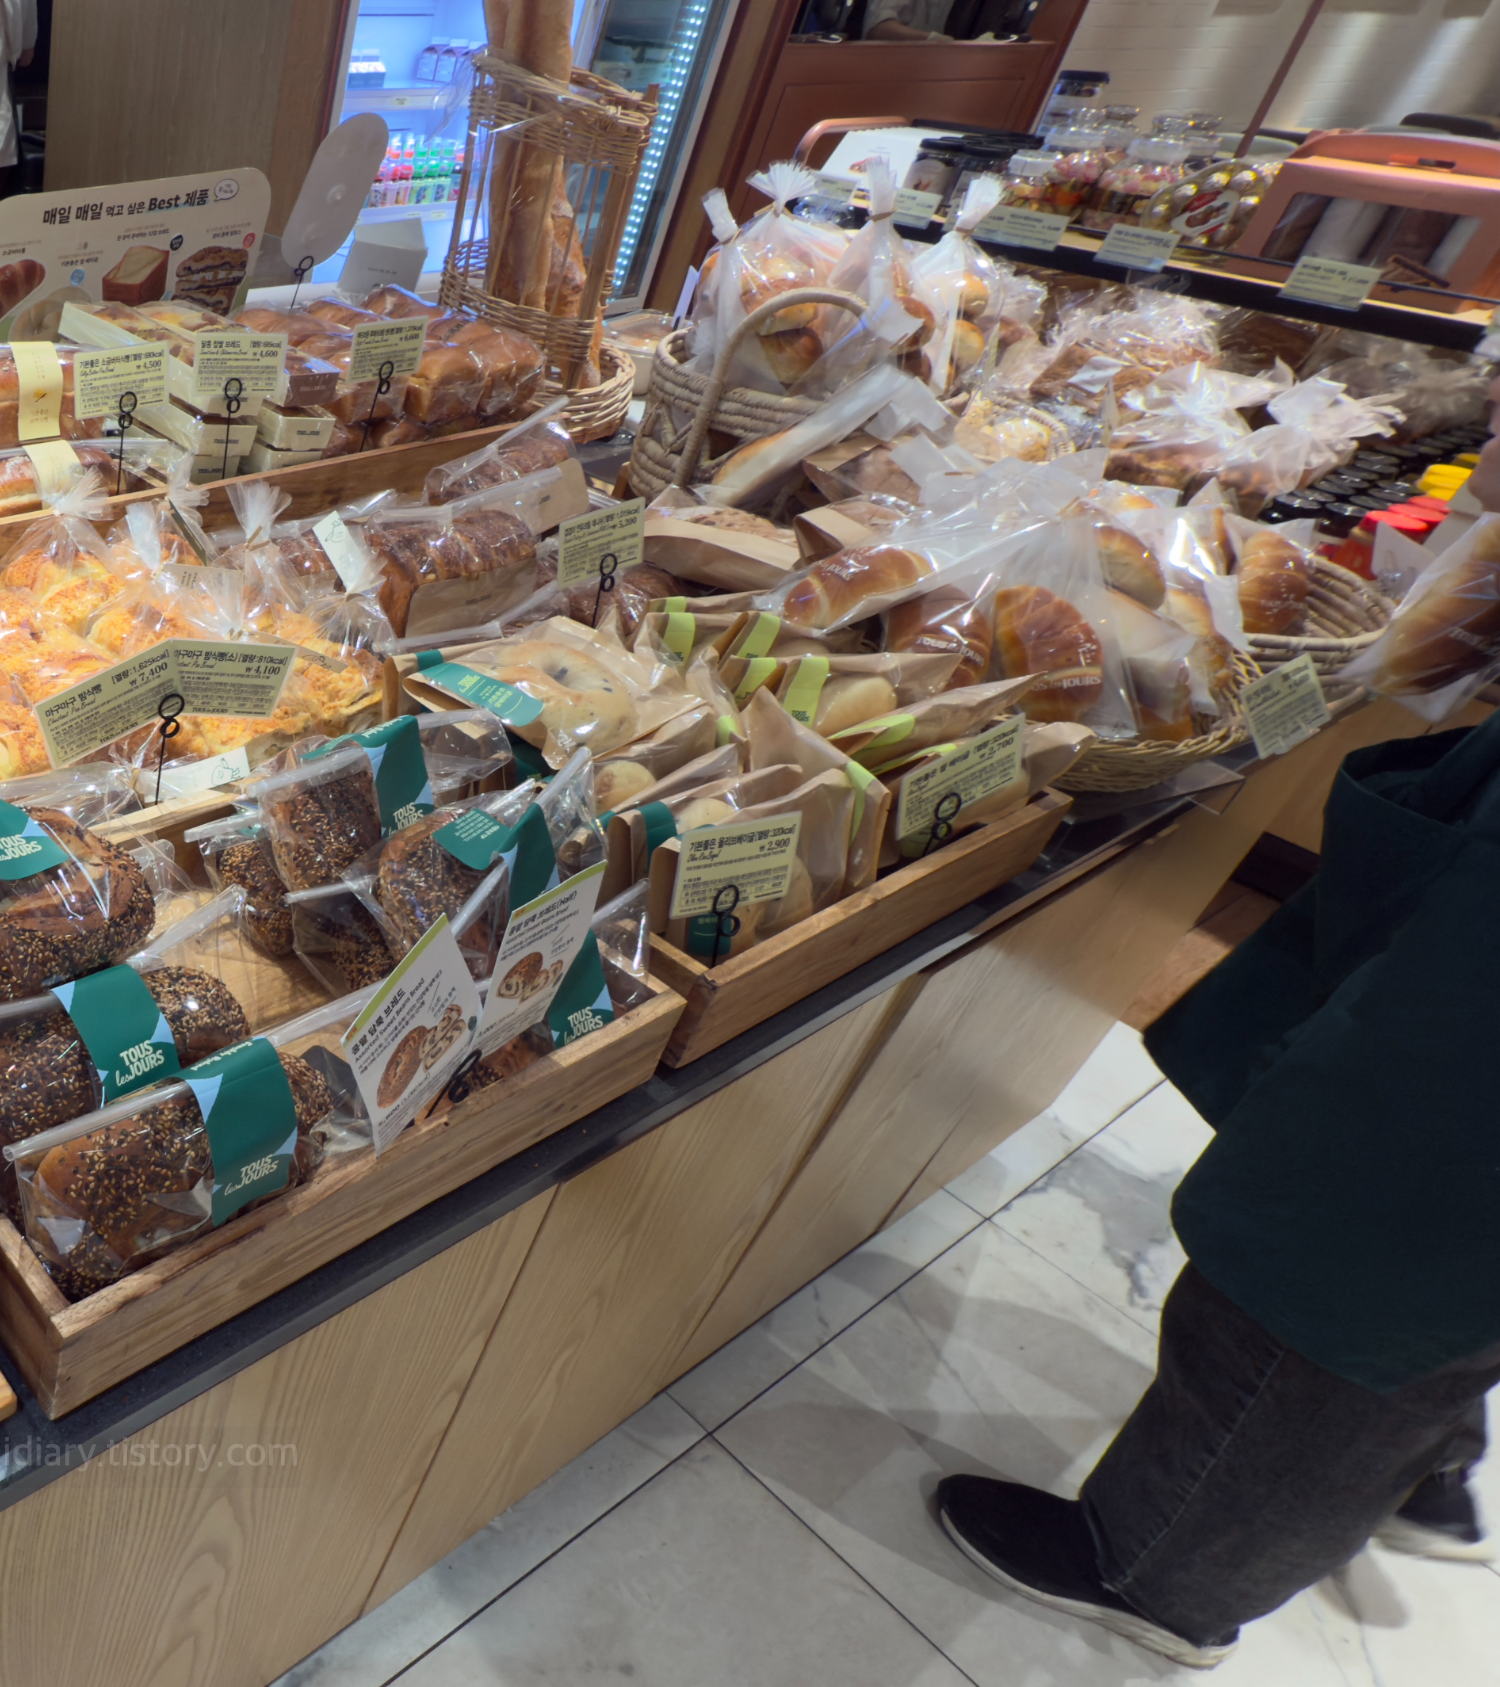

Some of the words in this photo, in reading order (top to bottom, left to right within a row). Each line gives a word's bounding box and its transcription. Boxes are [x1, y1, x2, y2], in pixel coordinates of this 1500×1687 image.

[42, 205, 72, 226] 매일
[74, 202, 104, 222] 매일
[105, 204, 124, 218] 먹고
[126, 201, 146, 215] 싶은
[148, 193, 180, 213] Best
[183, 188, 209, 207] 제품
[136, 357, 153, 367] 4,500
[258, 350, 278, 358] 4,600
[204, 650, 238, 663] 밤식빵(소)
[139, 662, 168, 682] 7,400
[254, 665, 281, 677] 4,100
[44, 697, 77, 718] 마구마구
[77, 684, 103, 703] 밤식빵
[988, 736, 1015, 756] 2,700
[392, 801, 416, 823] TOUS
[689, 838, 717, 853] 기본좋은
[717, 832, 756, 849] 올리브베이글
[766, 837, 791, 852] 2,900
[351, 1034, 369, 1056] 콩팥
[384, 987, 407, 1020] 브레드
[354, 1036, 381, 1064] Assorted
[379, 1013, 398, 1037] Sweet
[394, 995, 411, 1019] Beans
[409, 976, 426, 1000] Bread
[567, 1006, 593, 1023] TOUS
[119, 1039, 154, 1067] TOUS
[239, 1153, 274, 1178] TOUS
